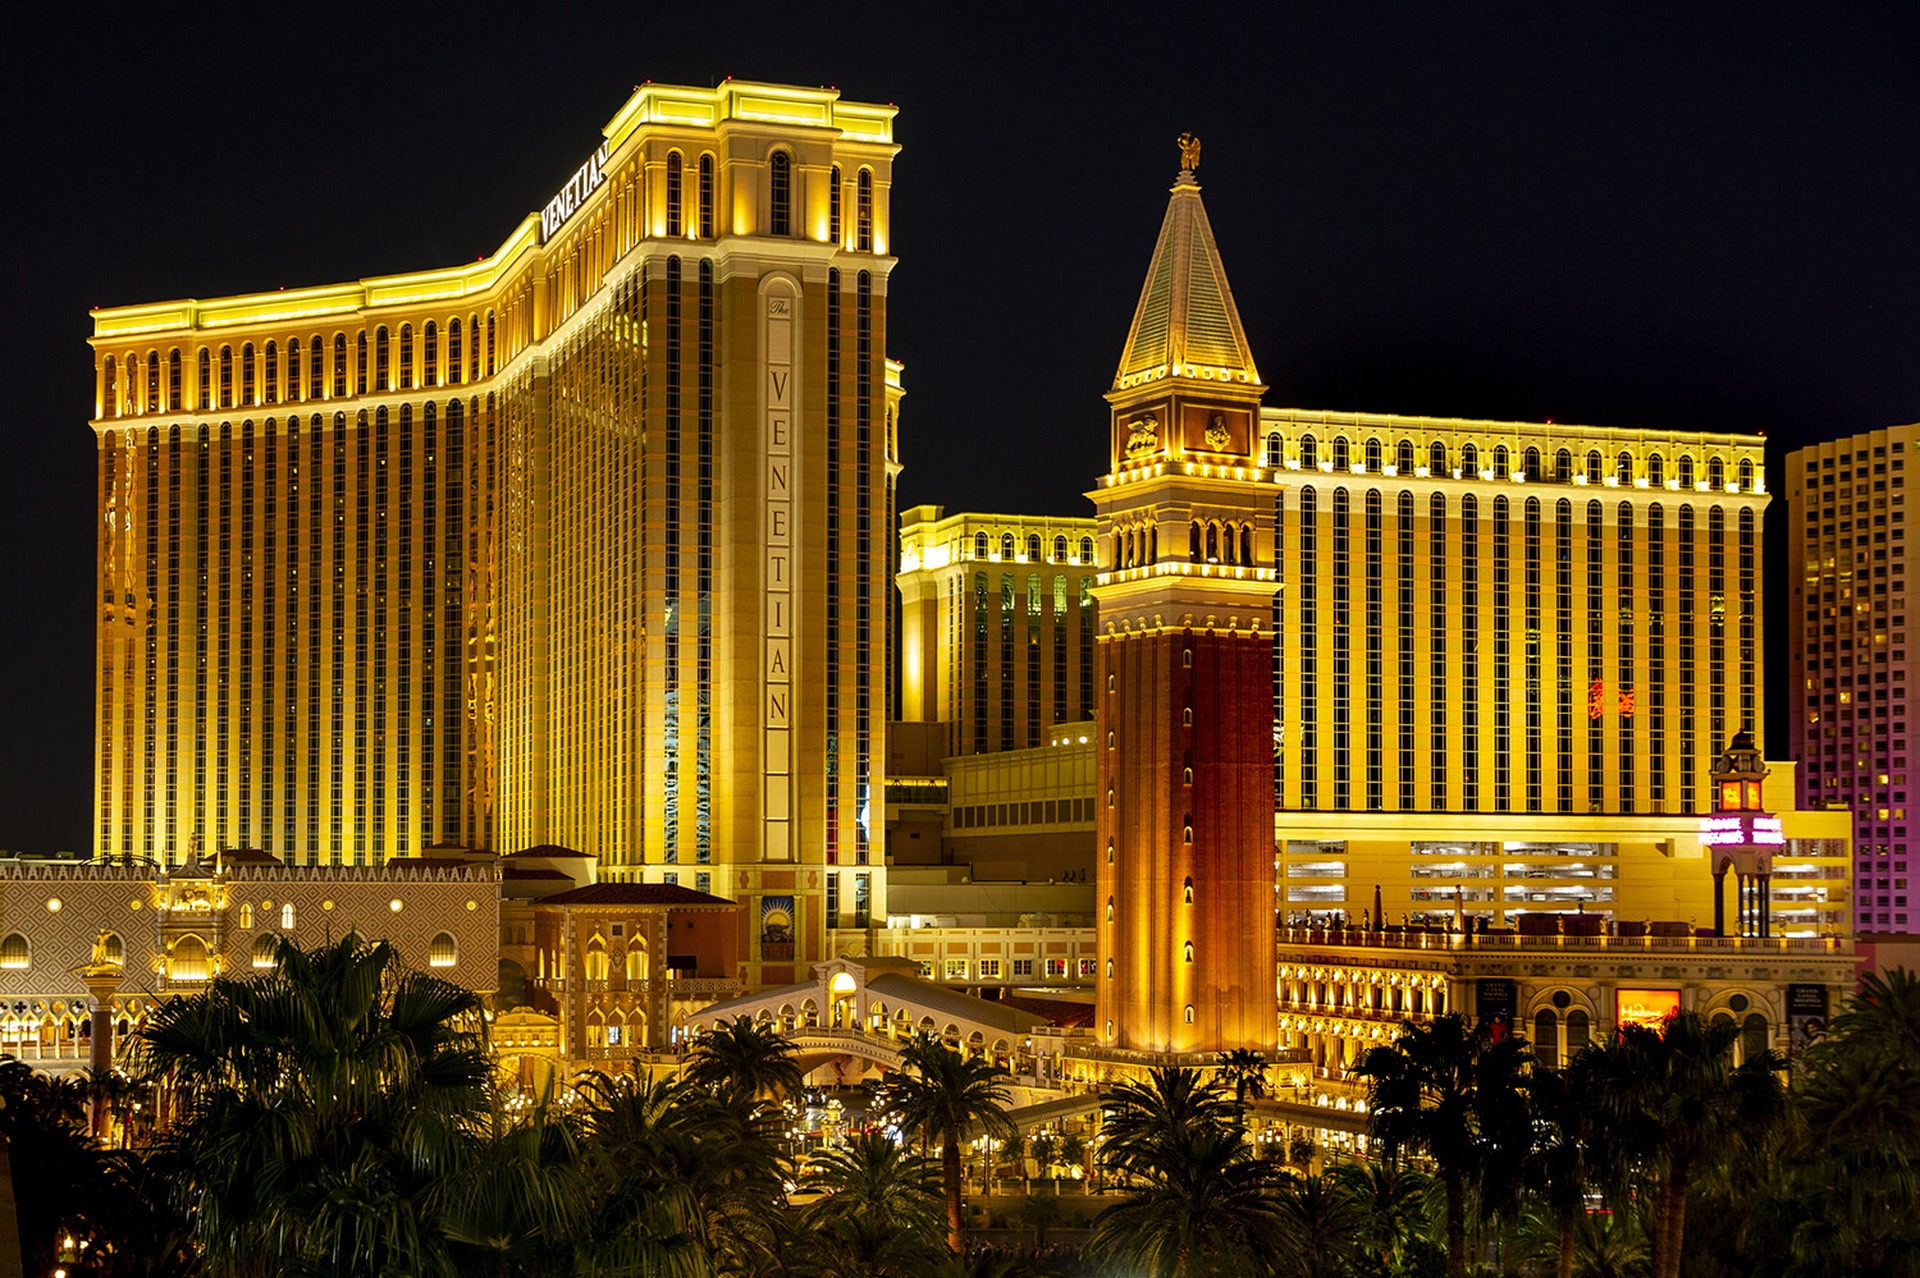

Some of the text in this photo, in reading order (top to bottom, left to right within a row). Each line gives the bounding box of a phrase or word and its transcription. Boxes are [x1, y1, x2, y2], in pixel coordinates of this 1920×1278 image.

[541, 139, 609, 242] VENETIAN
[769, 300, 789, 315] The
[769, 370, 789, 719] VENETIAN
